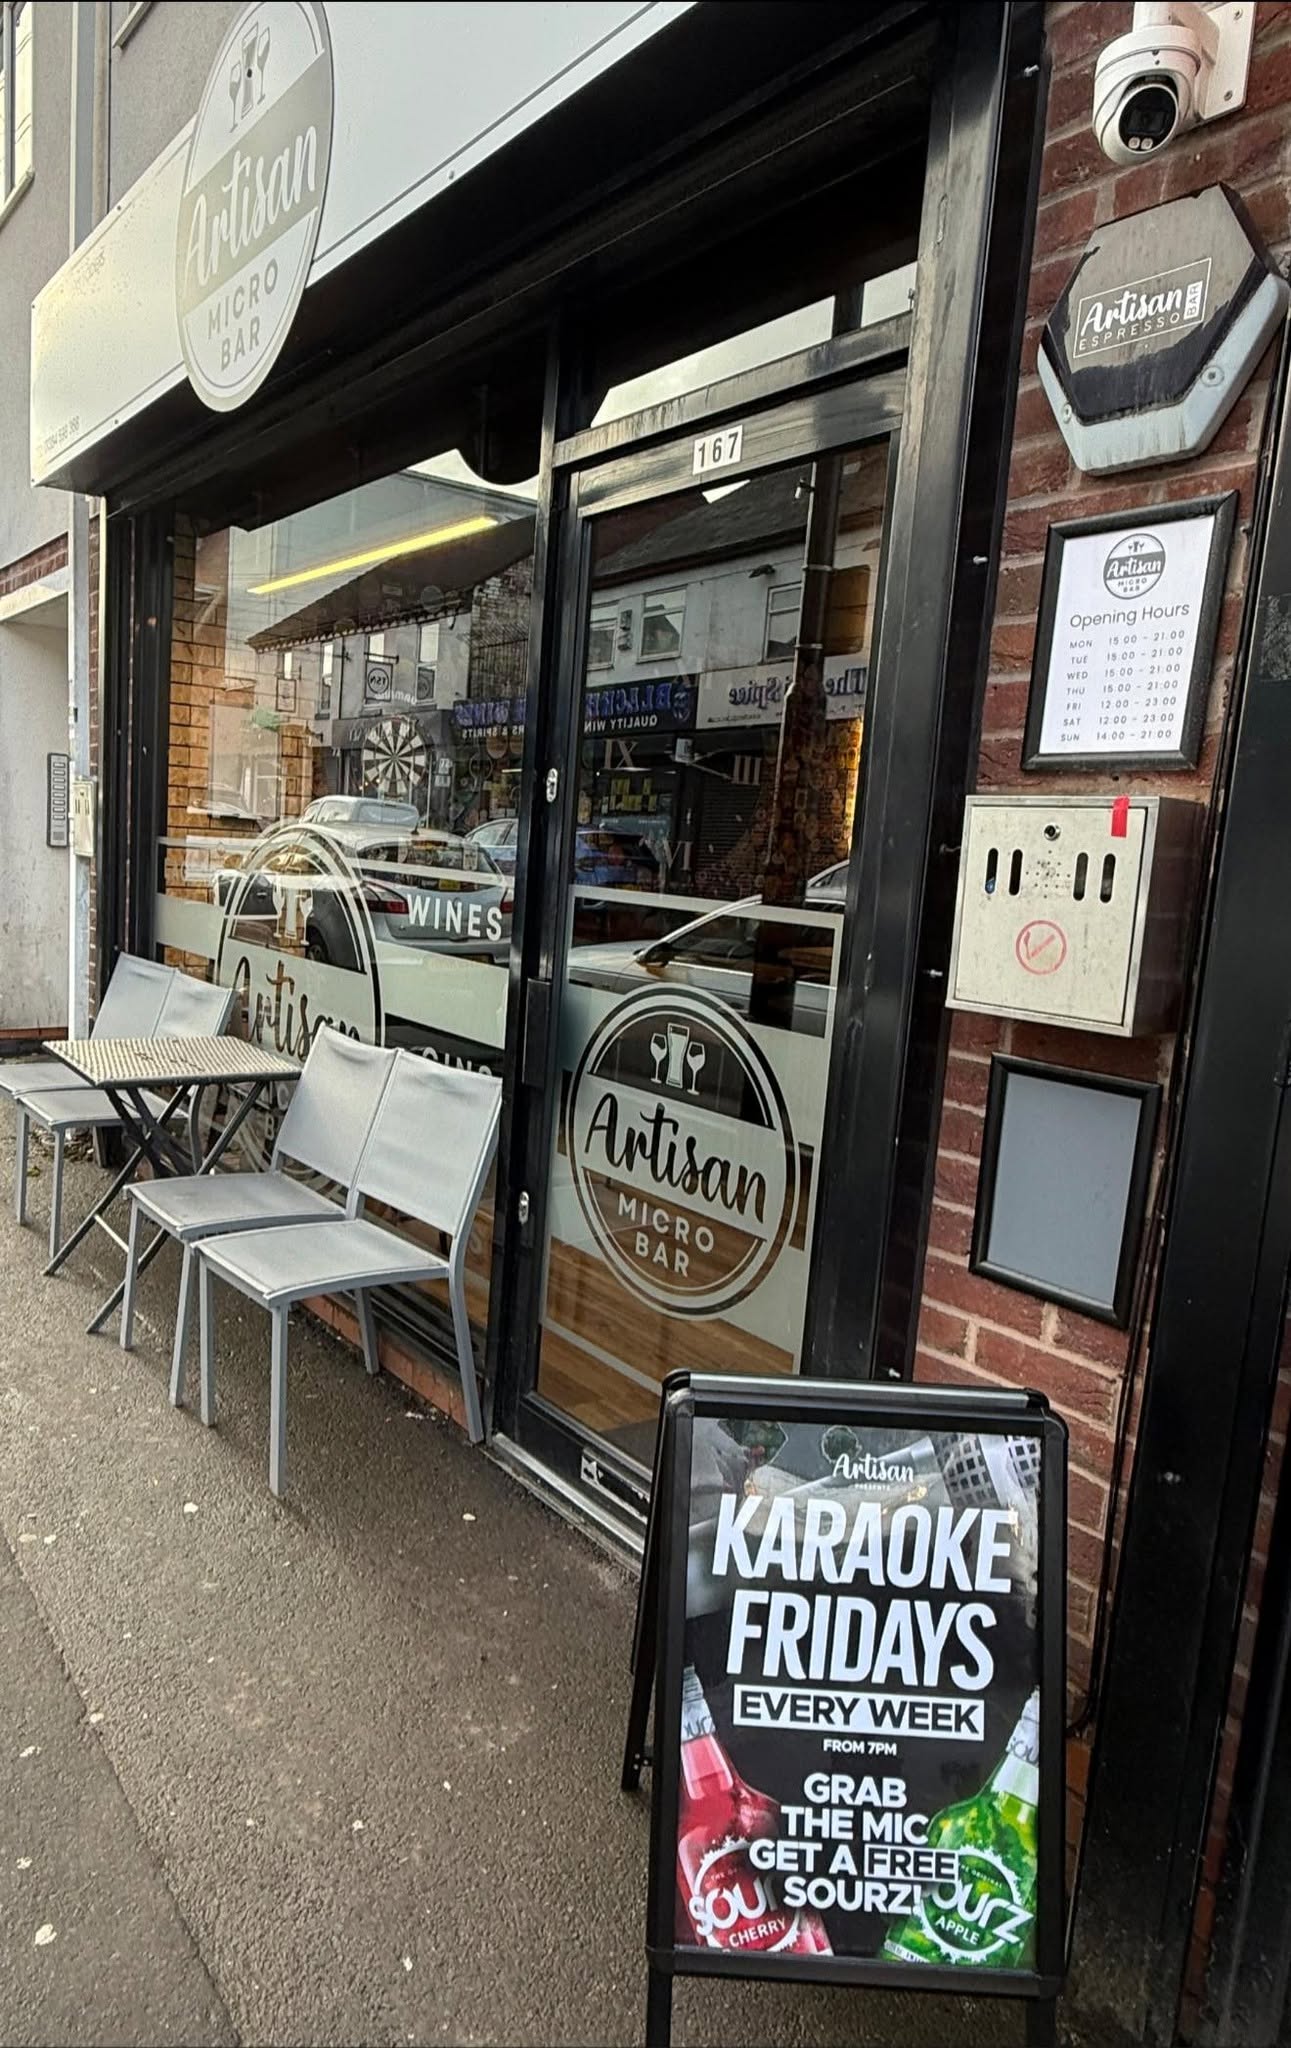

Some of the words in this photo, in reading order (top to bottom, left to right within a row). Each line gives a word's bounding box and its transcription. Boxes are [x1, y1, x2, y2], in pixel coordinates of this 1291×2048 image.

[184, 126, 317, 295] Artisan
[208, 257, 278, 340] MICRO
[1080, 289, 1183, 337] Artisan
[1186, 283, 1201, 317] BAR
[220, 315, 261, 371] BAR
[1079, 312, 1180, 351] ESPRESSO
[698, 431, 739, 468] 167
[1106, 556, 1161, 579] Artisan
[1117, 577, 1147, 587] MICRO
[1069, 609, 1137, 631] Opening
[1142, 603, 1190, 620] Hours
[1069, 640, 1093, 649] MON
[1071, 655, 1088, 665] TUE
[1066, 671, 1089, 680] WED
[1066, 687, 1085, 695] THU
[1063, 718, 1081, 727] SAT
[1066, 702, 1081, 711] FRI
[1060, 733, 1080, 742] SUN
[408, 893, 503, 941] WINES
[584, 1092, 767, 1224] Artisan
[617, 1191, 715, 1253] MICRO
[635, 1230, 689, 1277] BAR
[832, 1452, 914, 1483] Artisan
[711, 1493, 1018, 1593] KARAOKE
[726, 1588, 997, 1691] FRIDAYS
[740, 1690, 861, 1726] EVERY
[868, 1698, 980, 1734] WEEK
[823, 1738, 865, 1754] FROM
[867, 1741, 897, 1756] 7PM
[803, 1772, 907, 1808] GRAB
[780, 1805, 854, 1840] THE
[862, 1811, 929, 1845] MIC
[748, 1838, 823, 1873] GET
[829, 1844, 858, 1876] A
[867, 1847, 956, 1880] FREE
[782, 1875, 922, 1915] SOURZ!
[728, 1917, 787, 1948] CHERRY
[935, 1916, 980, 1946] APPLE
